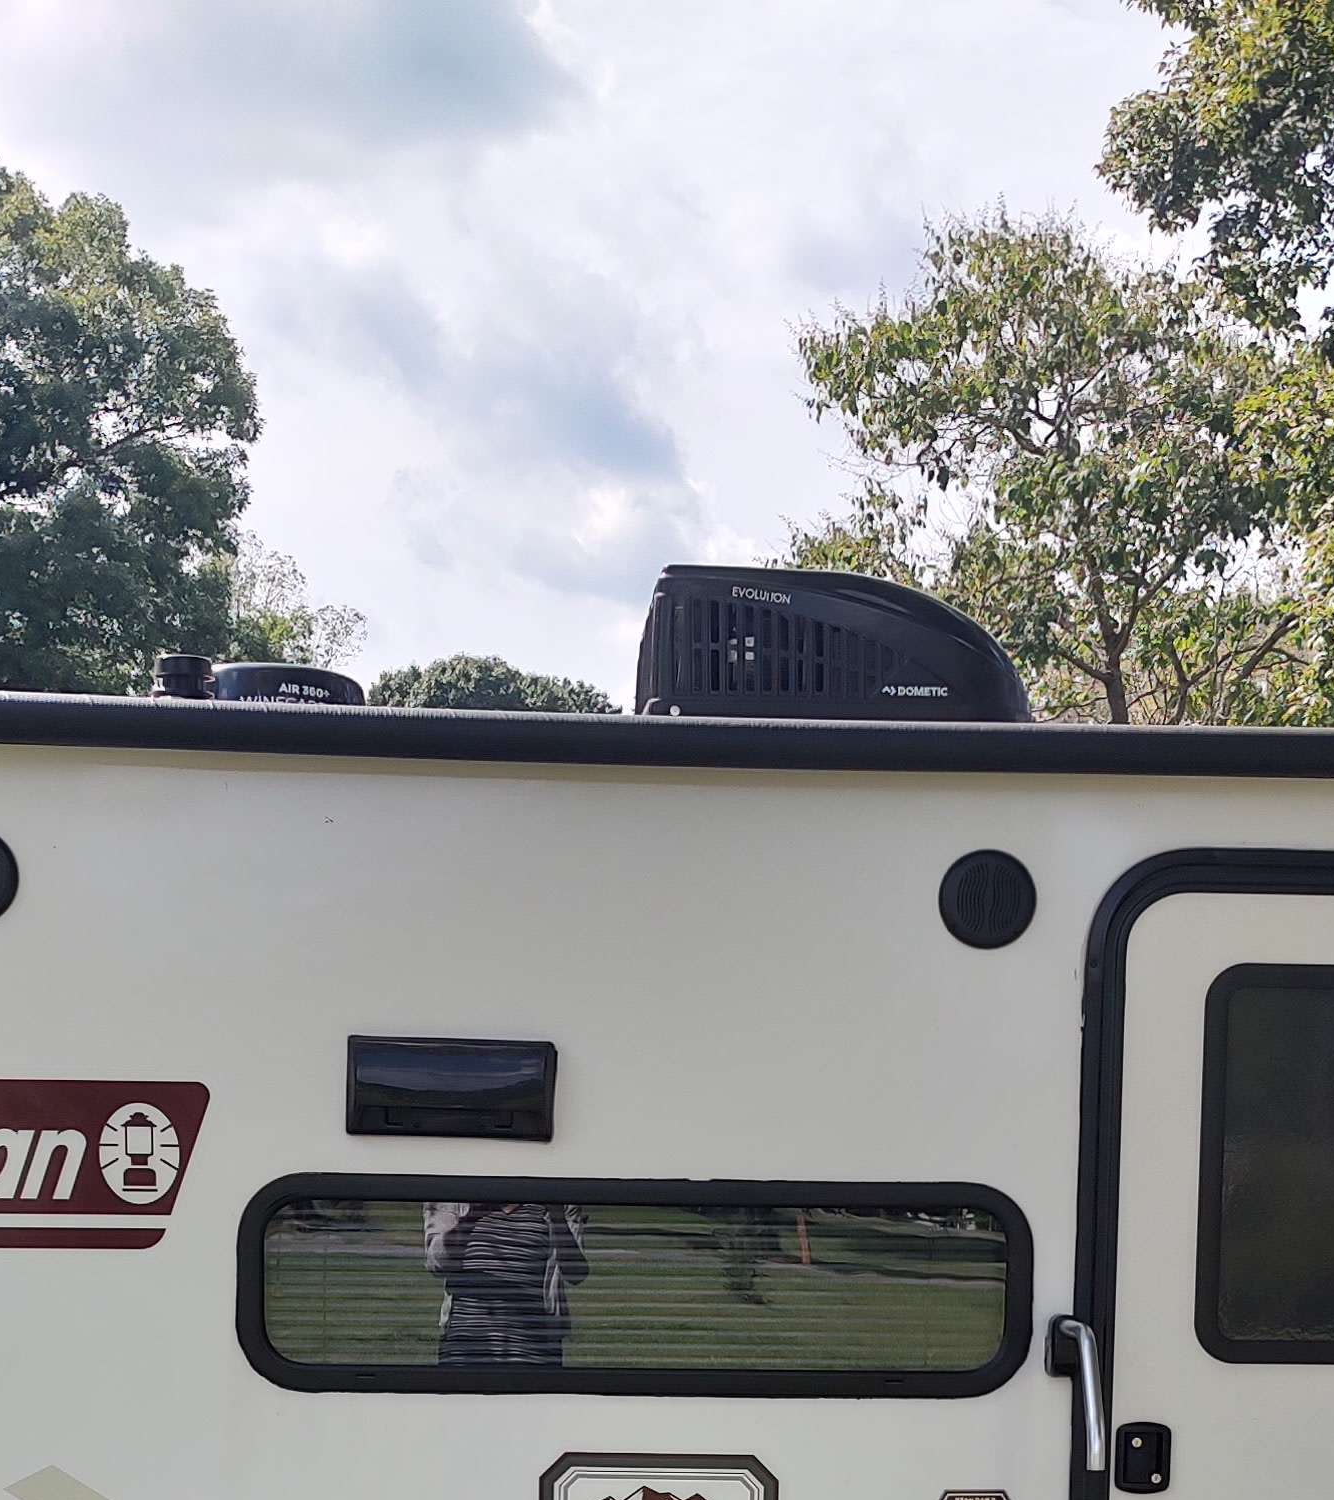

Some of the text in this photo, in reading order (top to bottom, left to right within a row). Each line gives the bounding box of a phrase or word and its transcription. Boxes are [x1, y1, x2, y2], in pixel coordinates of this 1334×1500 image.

[732, 585, 791, 604] EVOLUTION
[279, 682, 300, 695] AIR
[897, 685, 948, 697] DOMETIC
